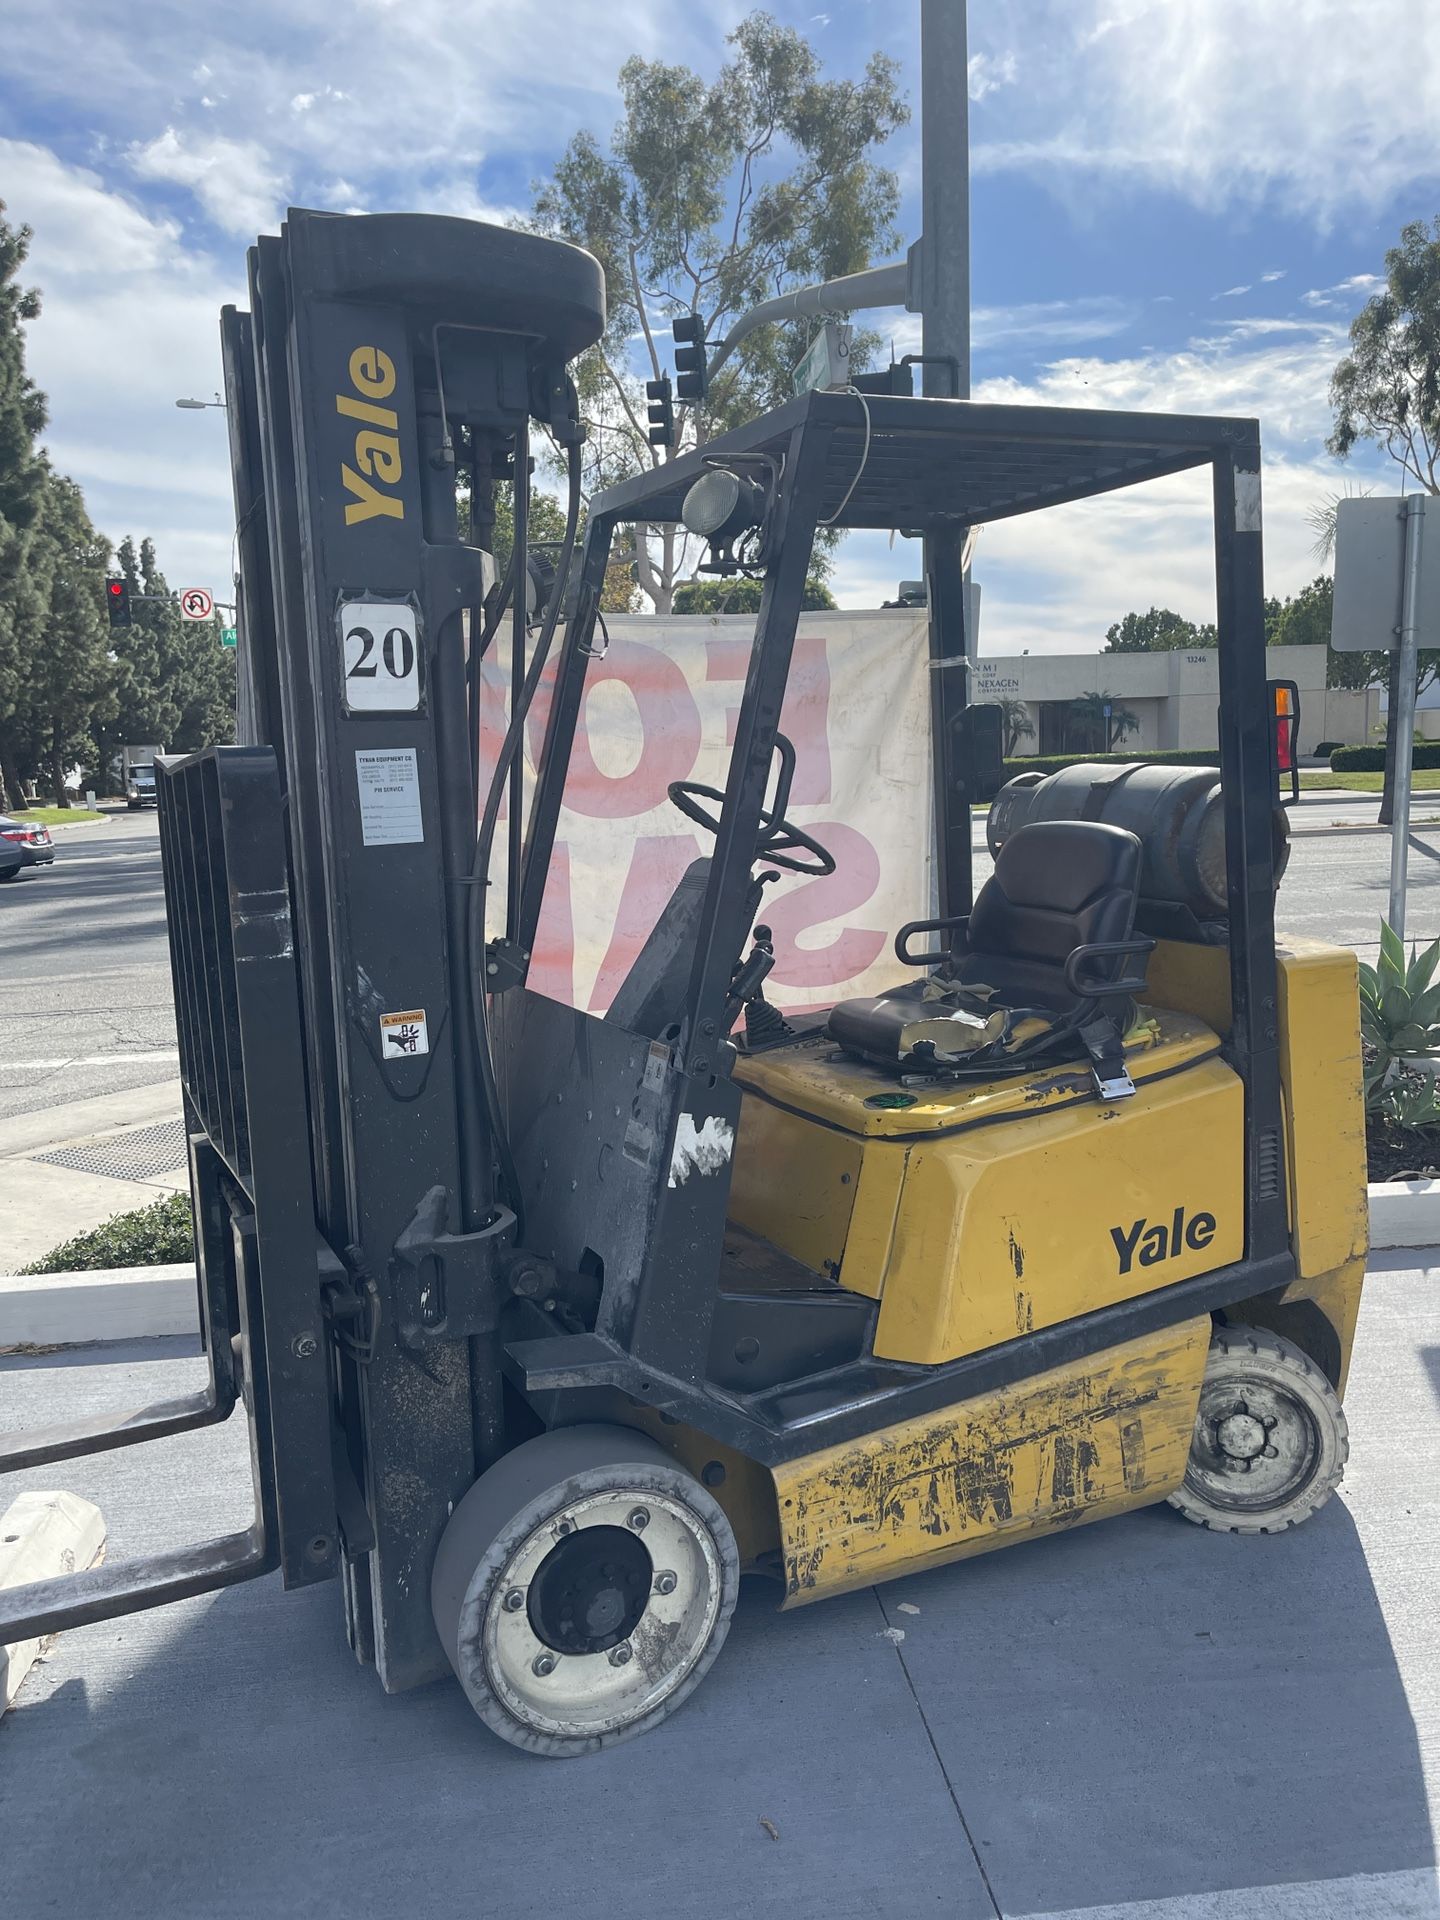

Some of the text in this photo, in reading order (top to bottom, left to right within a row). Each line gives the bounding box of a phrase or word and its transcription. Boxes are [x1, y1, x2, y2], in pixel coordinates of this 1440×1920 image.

[336, 345, 405, 527] Yale
[344, 626, 415, 680] 20
[1185, 655, 1207, 664] 13246
[977, 679, 1019, 688] NEXAGEN
[391, 1013, 423, 1023] WARNING
[1110, 1206, 1217, 1275] Yale
